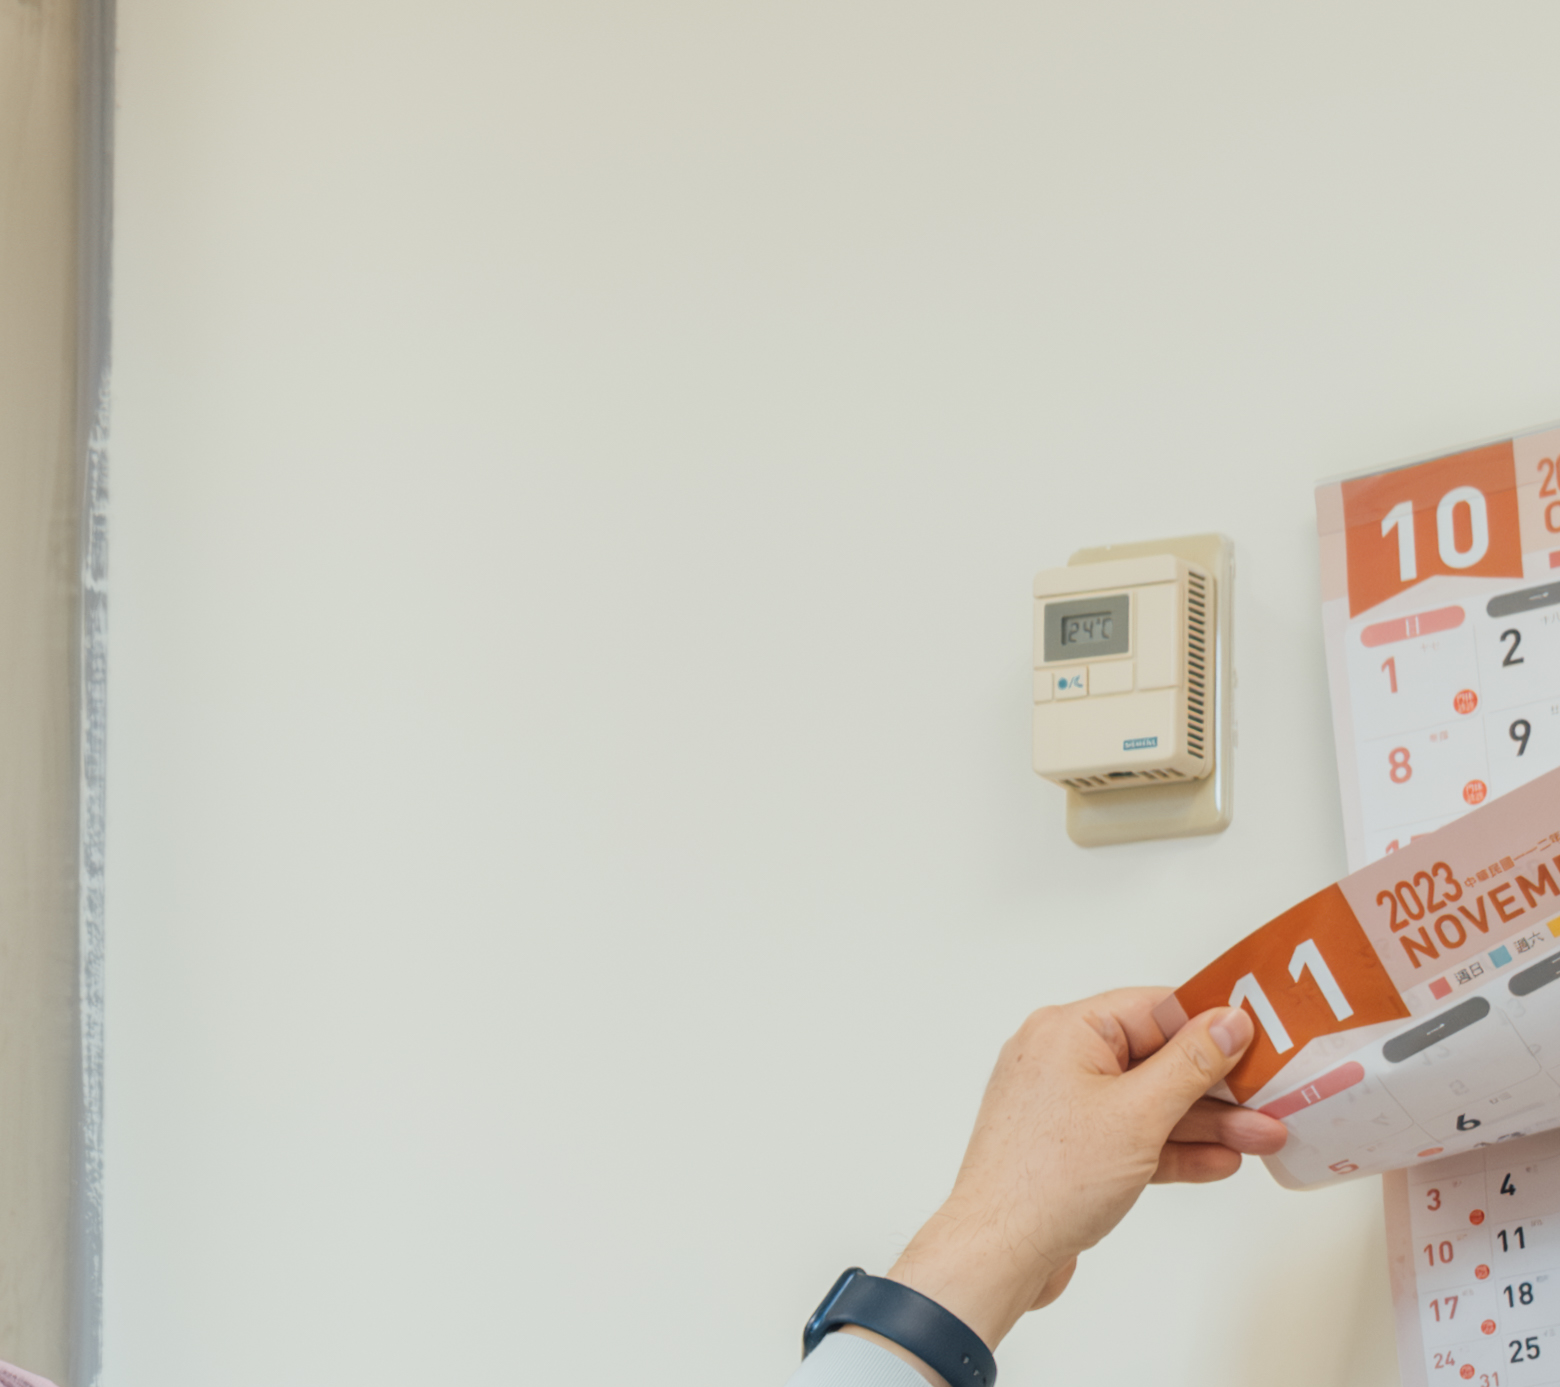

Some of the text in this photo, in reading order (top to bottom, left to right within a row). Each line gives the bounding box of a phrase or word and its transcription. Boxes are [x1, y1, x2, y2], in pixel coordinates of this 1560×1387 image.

[1380, 484, 1490, 583] 10
[1380, 656, 1398, 694] 1
[1498, 629, 1525, 668] 2
[1388, 746, 1413, 785] 8
[1508, 718, 1533, 757] 9
[1375, 861, 1466, 934] 2023
[1453, 961, 1486, 986] 週日
[1513, 930, 1546, 955] 週六
[1227, 937, 1355, 1056] 11
[1426, 1188, 1442, 1211] 3
[1500, 1173, 1516, 1196] 4
[1423, 1240, 1454, 1266] 10
[1497, 1226, 1527, 1252] 11
